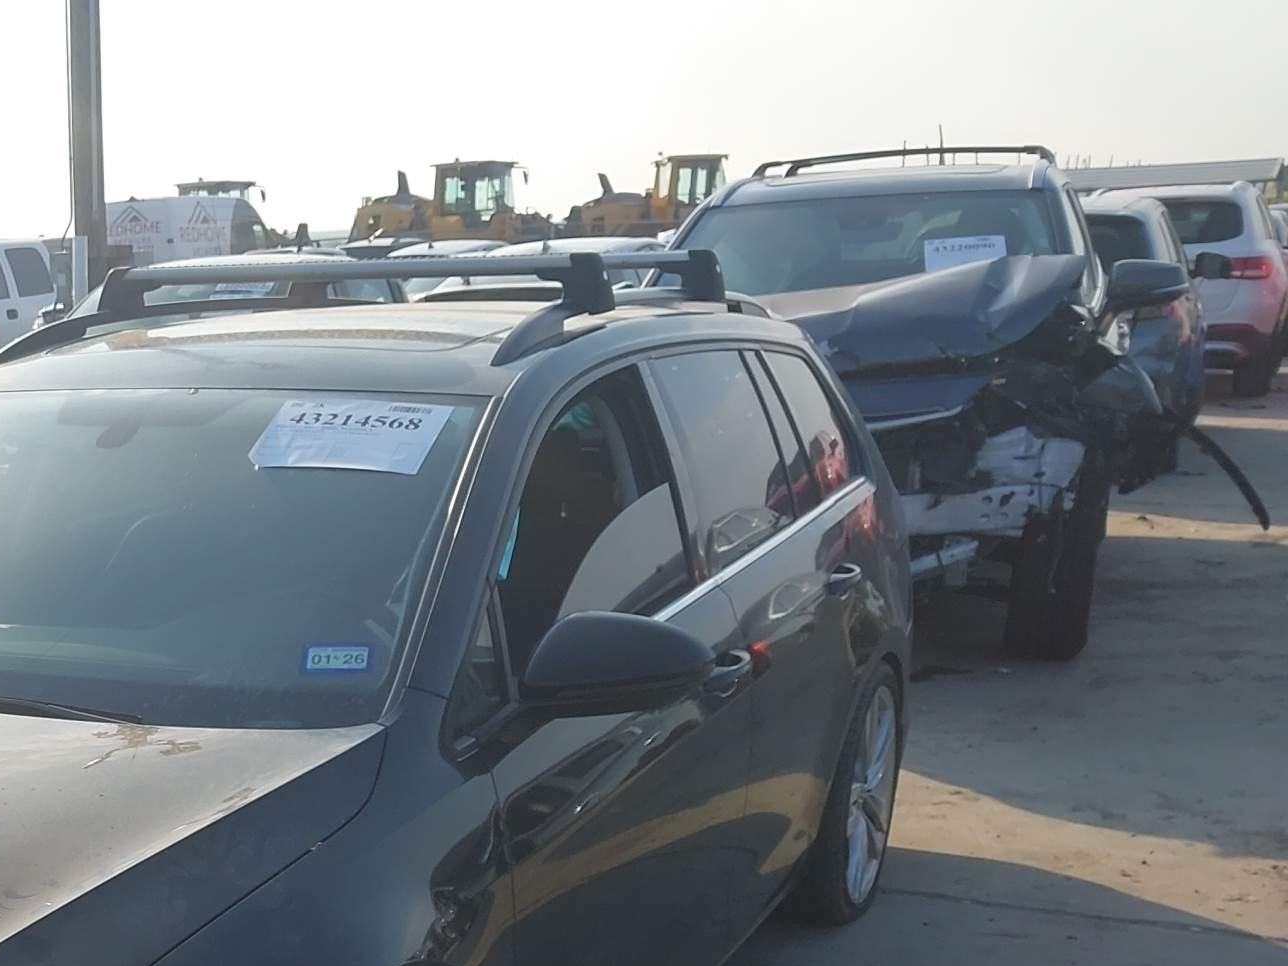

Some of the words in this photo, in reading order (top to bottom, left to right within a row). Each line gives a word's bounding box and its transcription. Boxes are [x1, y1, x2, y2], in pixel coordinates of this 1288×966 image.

[289, 411, 424, 431] 43214568
[312, 653, 332, 666] 01
[342, 653, 366, 666] 26
